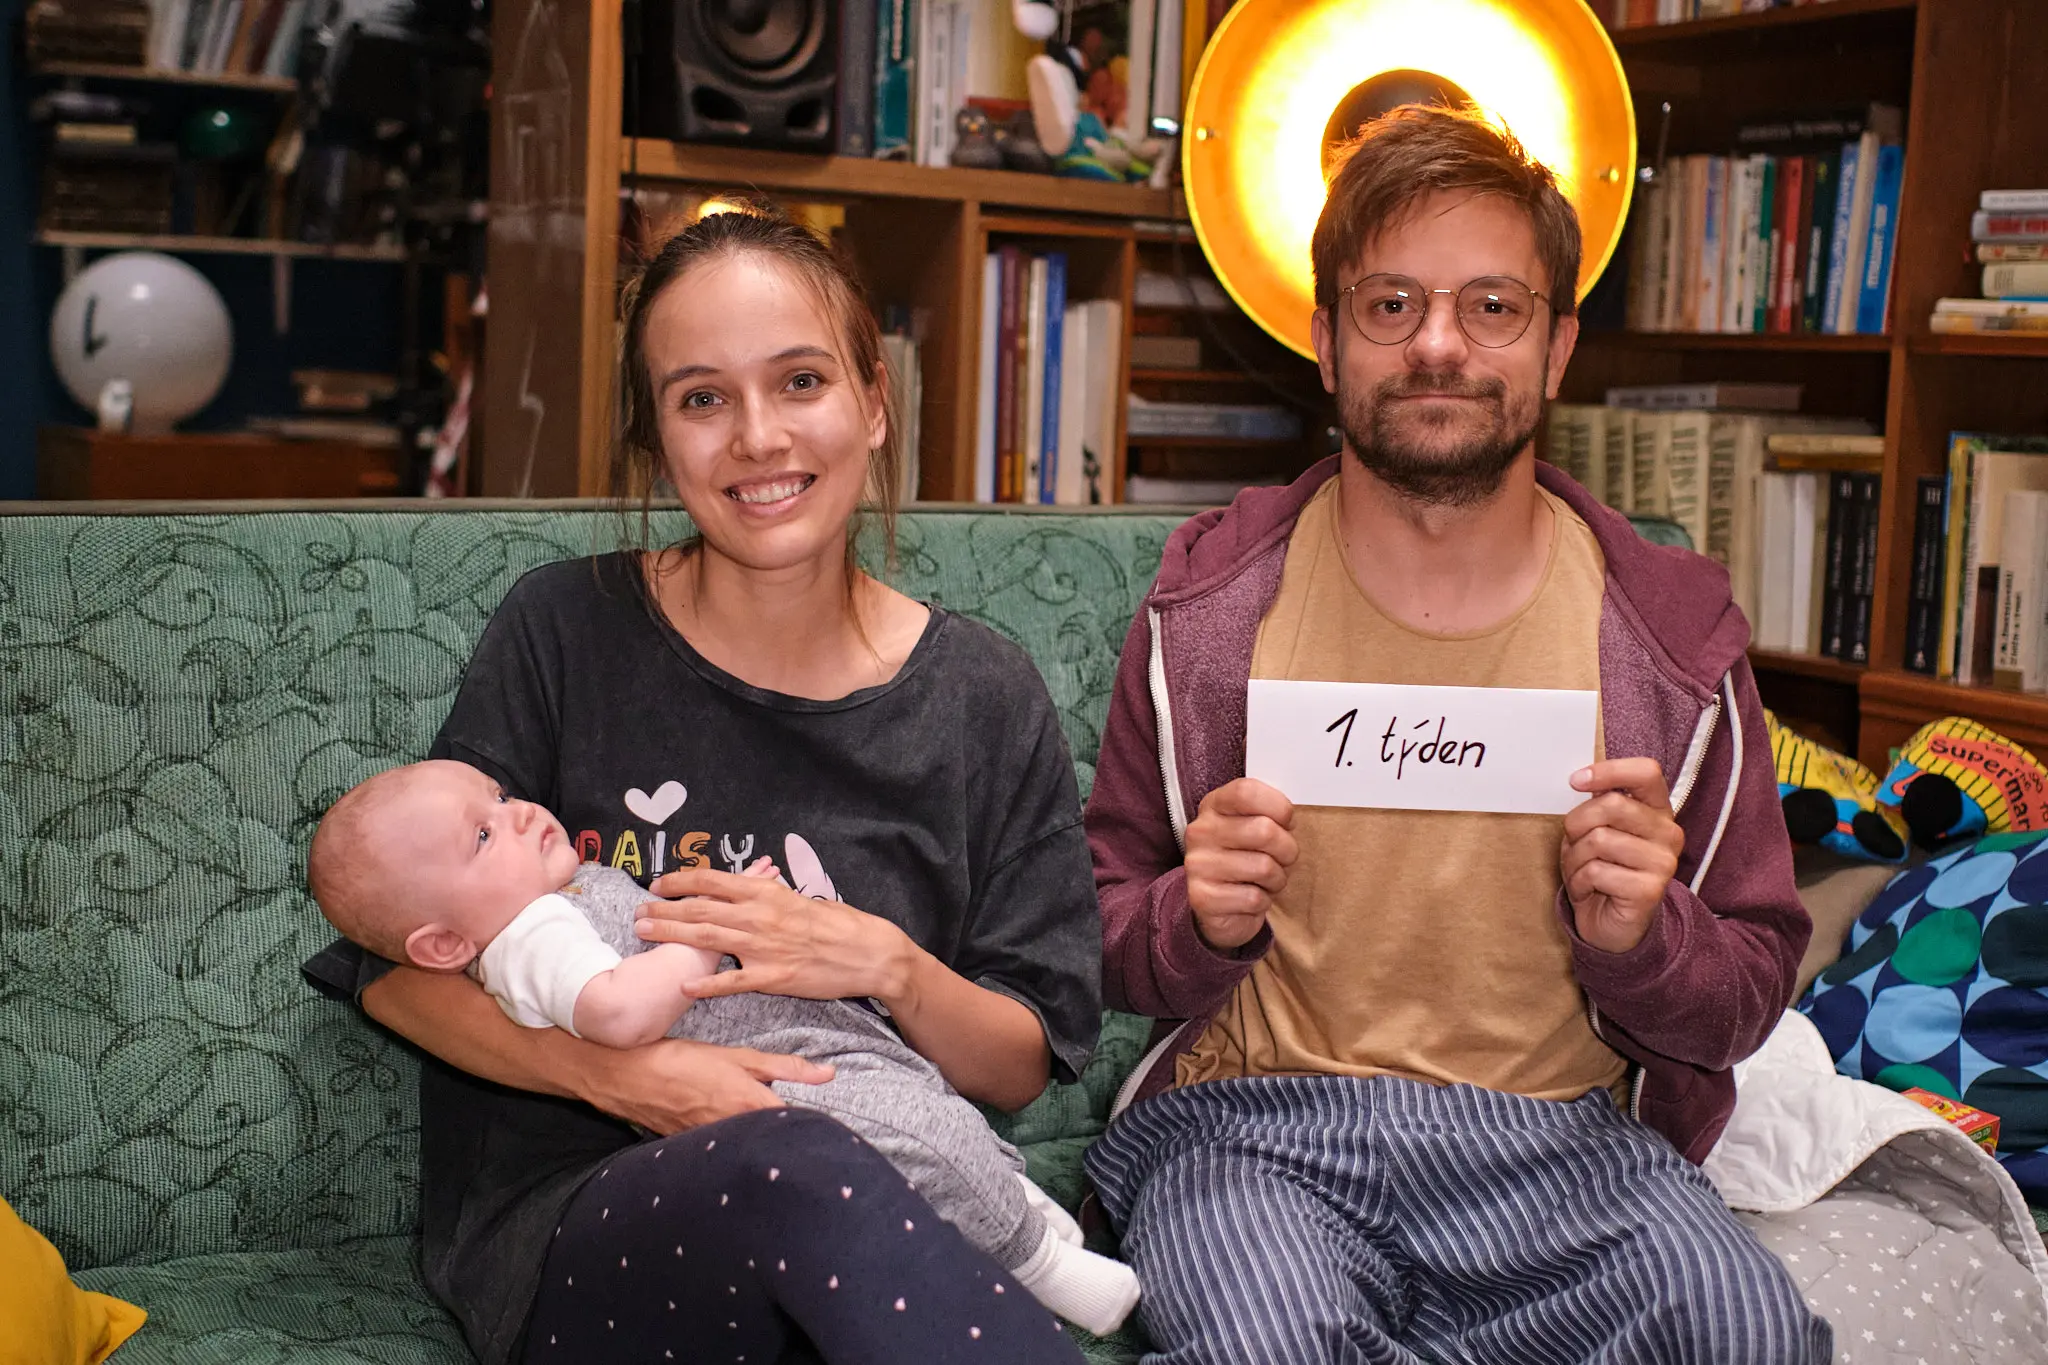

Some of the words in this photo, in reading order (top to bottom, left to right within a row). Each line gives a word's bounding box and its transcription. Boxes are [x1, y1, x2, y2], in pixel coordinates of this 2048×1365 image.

[1326, 708, 1358, 768] 1.
[1381, 716, 1485, 780] týden
[574, 829, 755, 879] DAISY
